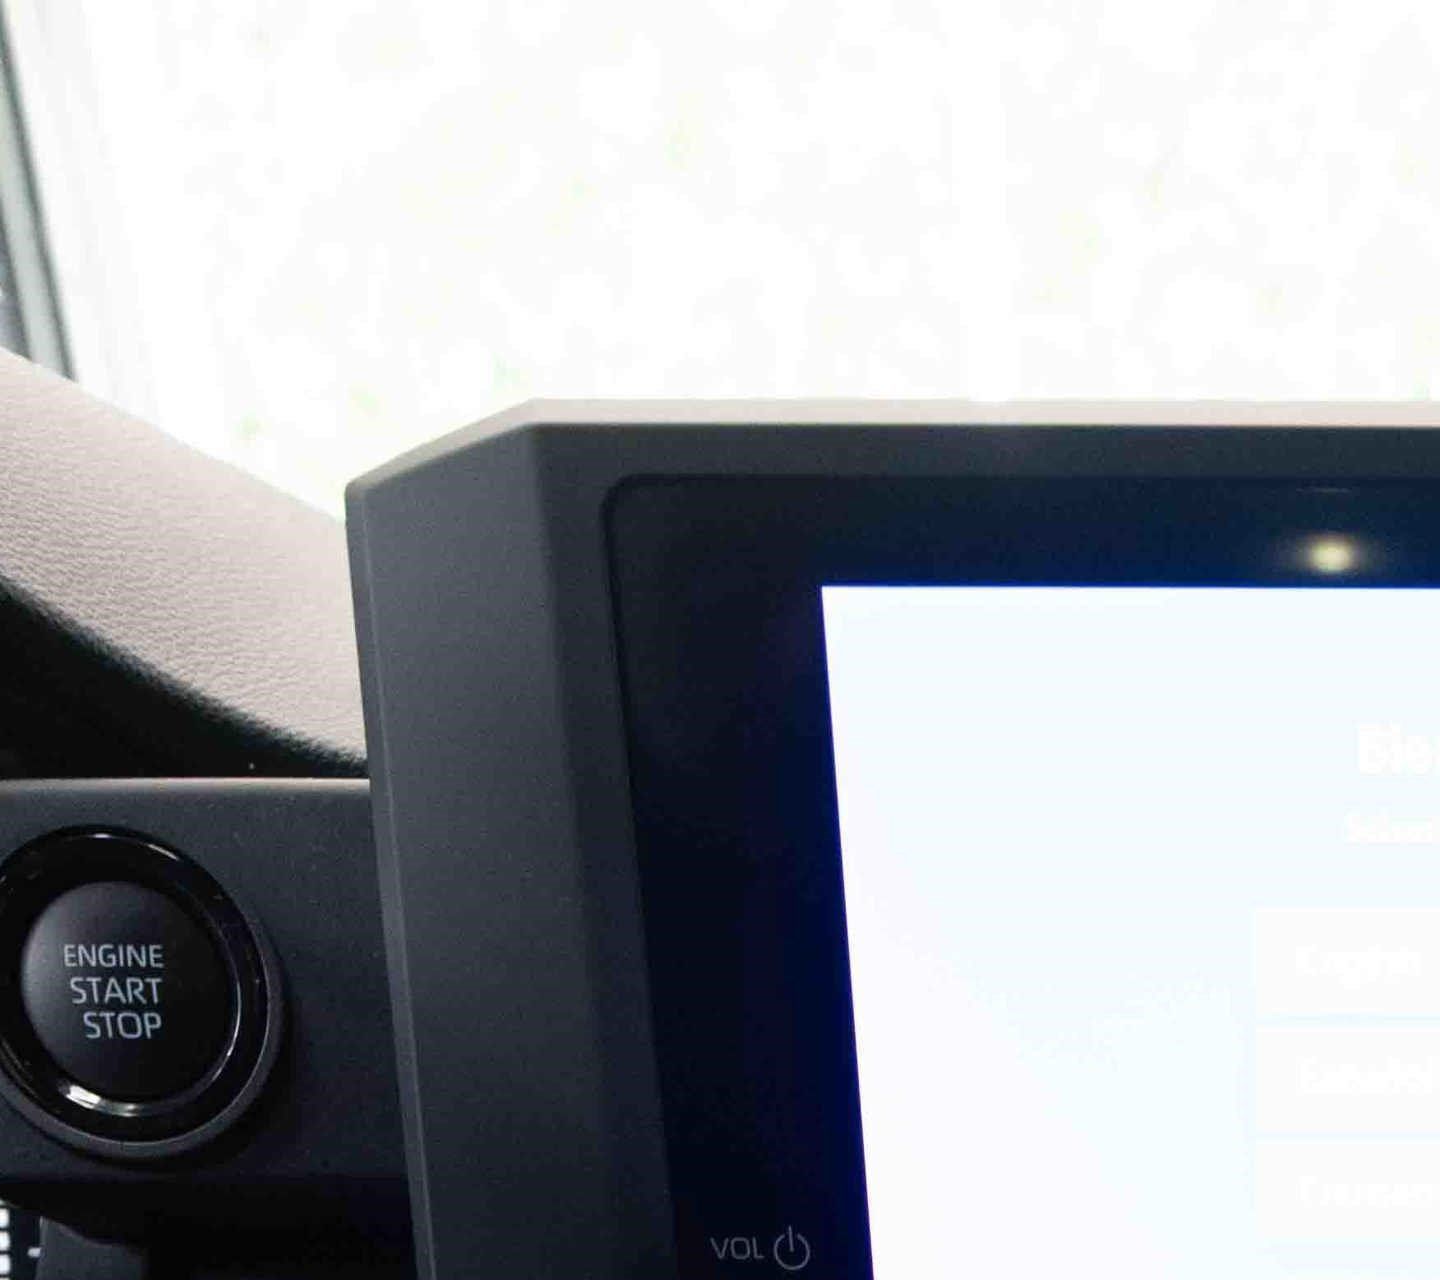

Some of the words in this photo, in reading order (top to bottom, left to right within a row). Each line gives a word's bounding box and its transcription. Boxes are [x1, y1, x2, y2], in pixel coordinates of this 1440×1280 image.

[64, 943, 163, 968] ENGINE
[70, 977, 162, 1004] START
[83, 1011, 162, 1039] STOP
[709, 1236, 765, 1261] VOL
